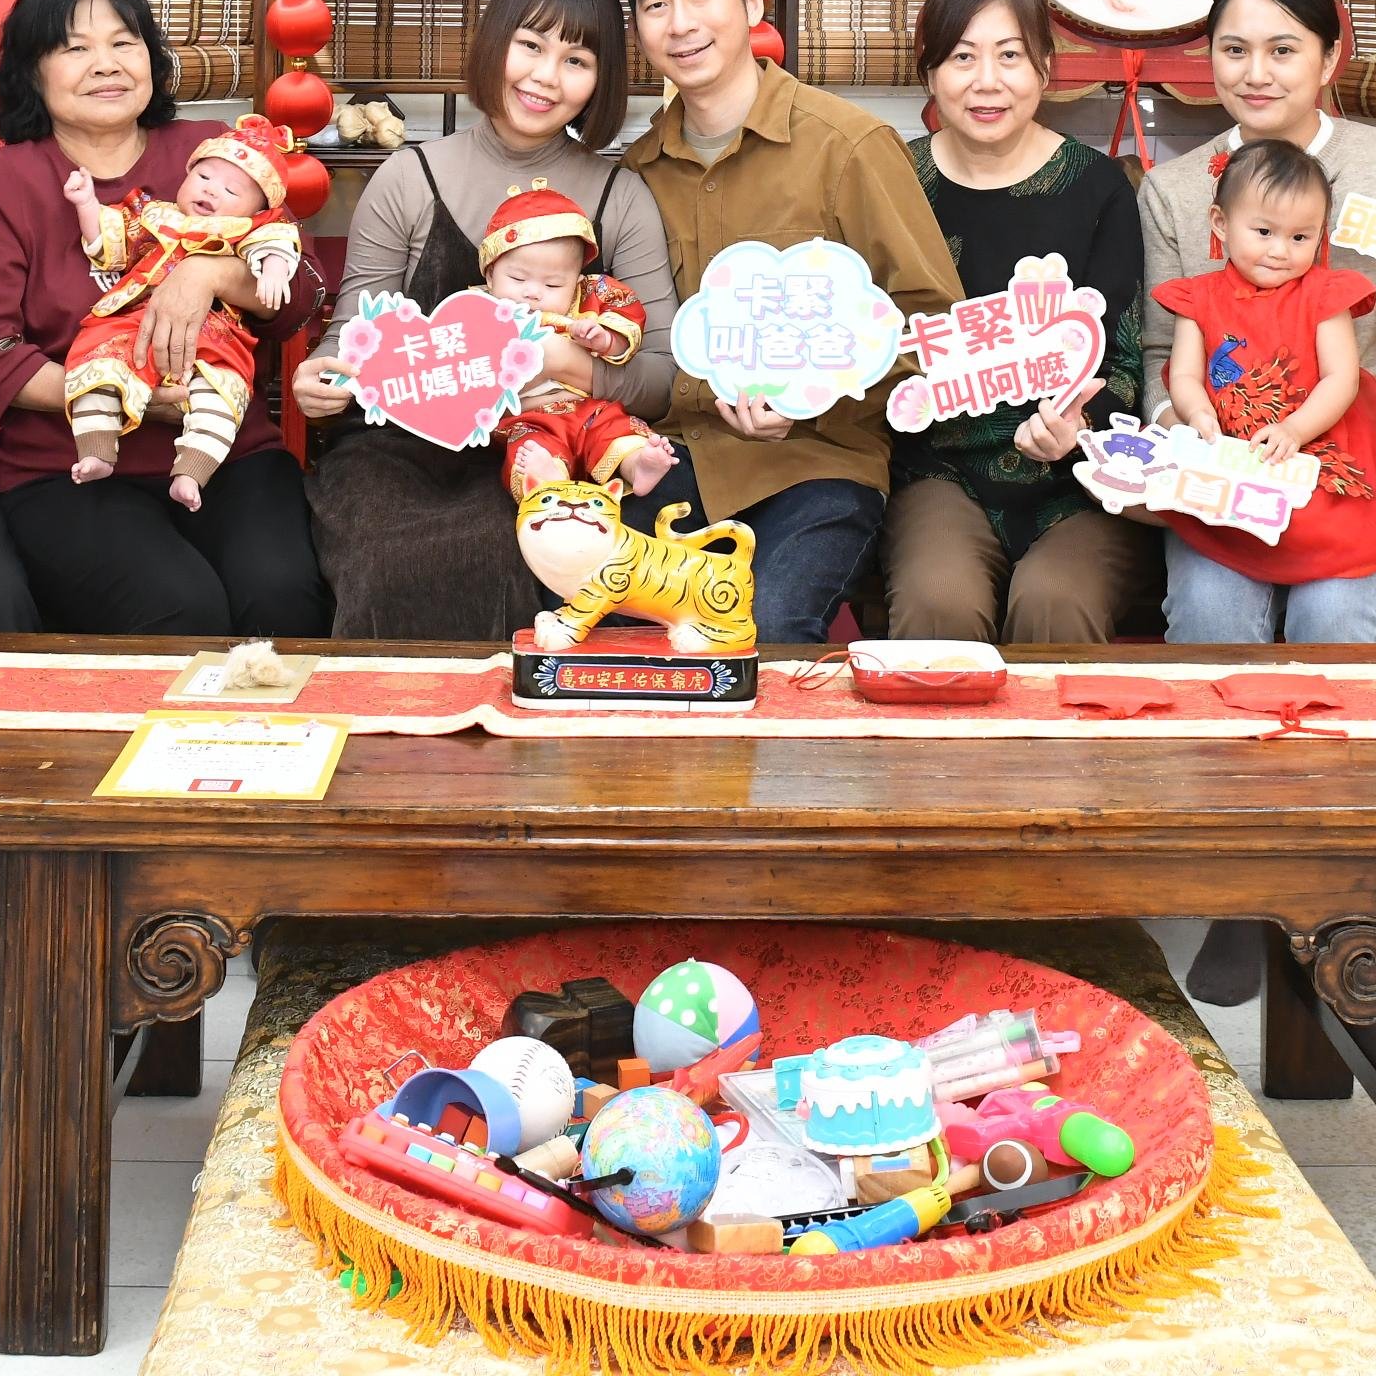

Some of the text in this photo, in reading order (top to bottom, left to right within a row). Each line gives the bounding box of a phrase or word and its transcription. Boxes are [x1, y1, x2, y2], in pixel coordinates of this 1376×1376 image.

[735, 274, 834, 320] 卡緊
[393, 322, 468, 366] 卡緊
[708, 323, 856, 370] 叫爸爸
[900, 296, 1015, 367] 卡緊
[382, 355, 496, 407] 叫媽媽
[932, 351, 1072, 416] 叫阿嬤
